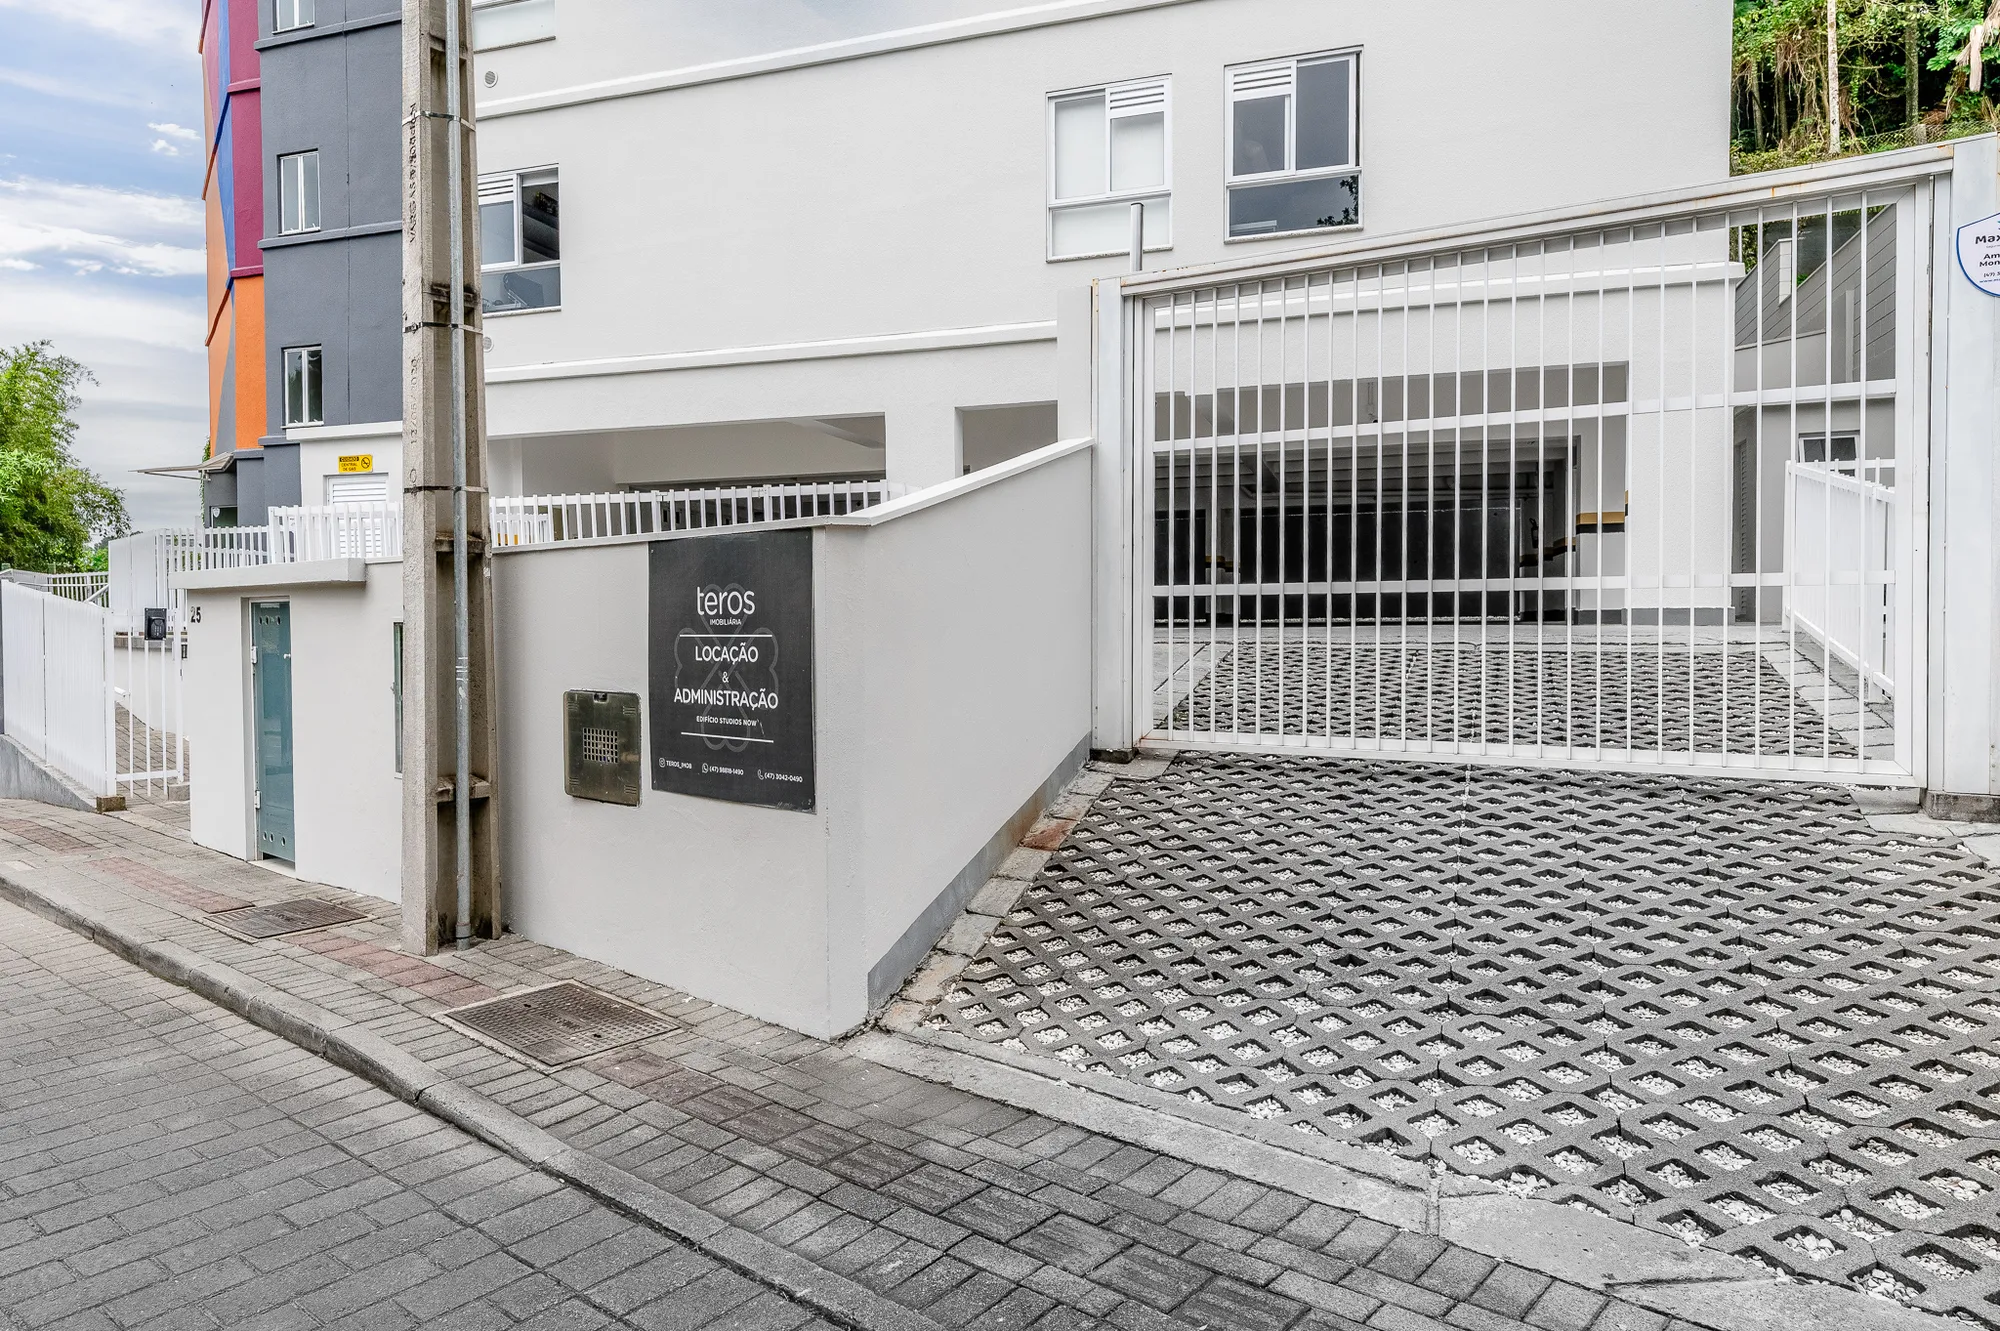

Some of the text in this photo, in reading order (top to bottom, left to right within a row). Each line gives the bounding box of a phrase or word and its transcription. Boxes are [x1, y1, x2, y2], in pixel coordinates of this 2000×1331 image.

[696, 586, 756, 616] teros
[190, 605, 202, 624] 25
[709, 616, 742, 626] IMOBILIÁRIA
[695, 642, 759, 665] LOCAÇÃO
[721, 671, 730, 683] &
[673, 687, 779, 711] ADMINISTRAÇÃO
[696, 714, 757, 727] EDIFÍCIO STUDIOS NOW
[764, 772, 775, 780] (47)
